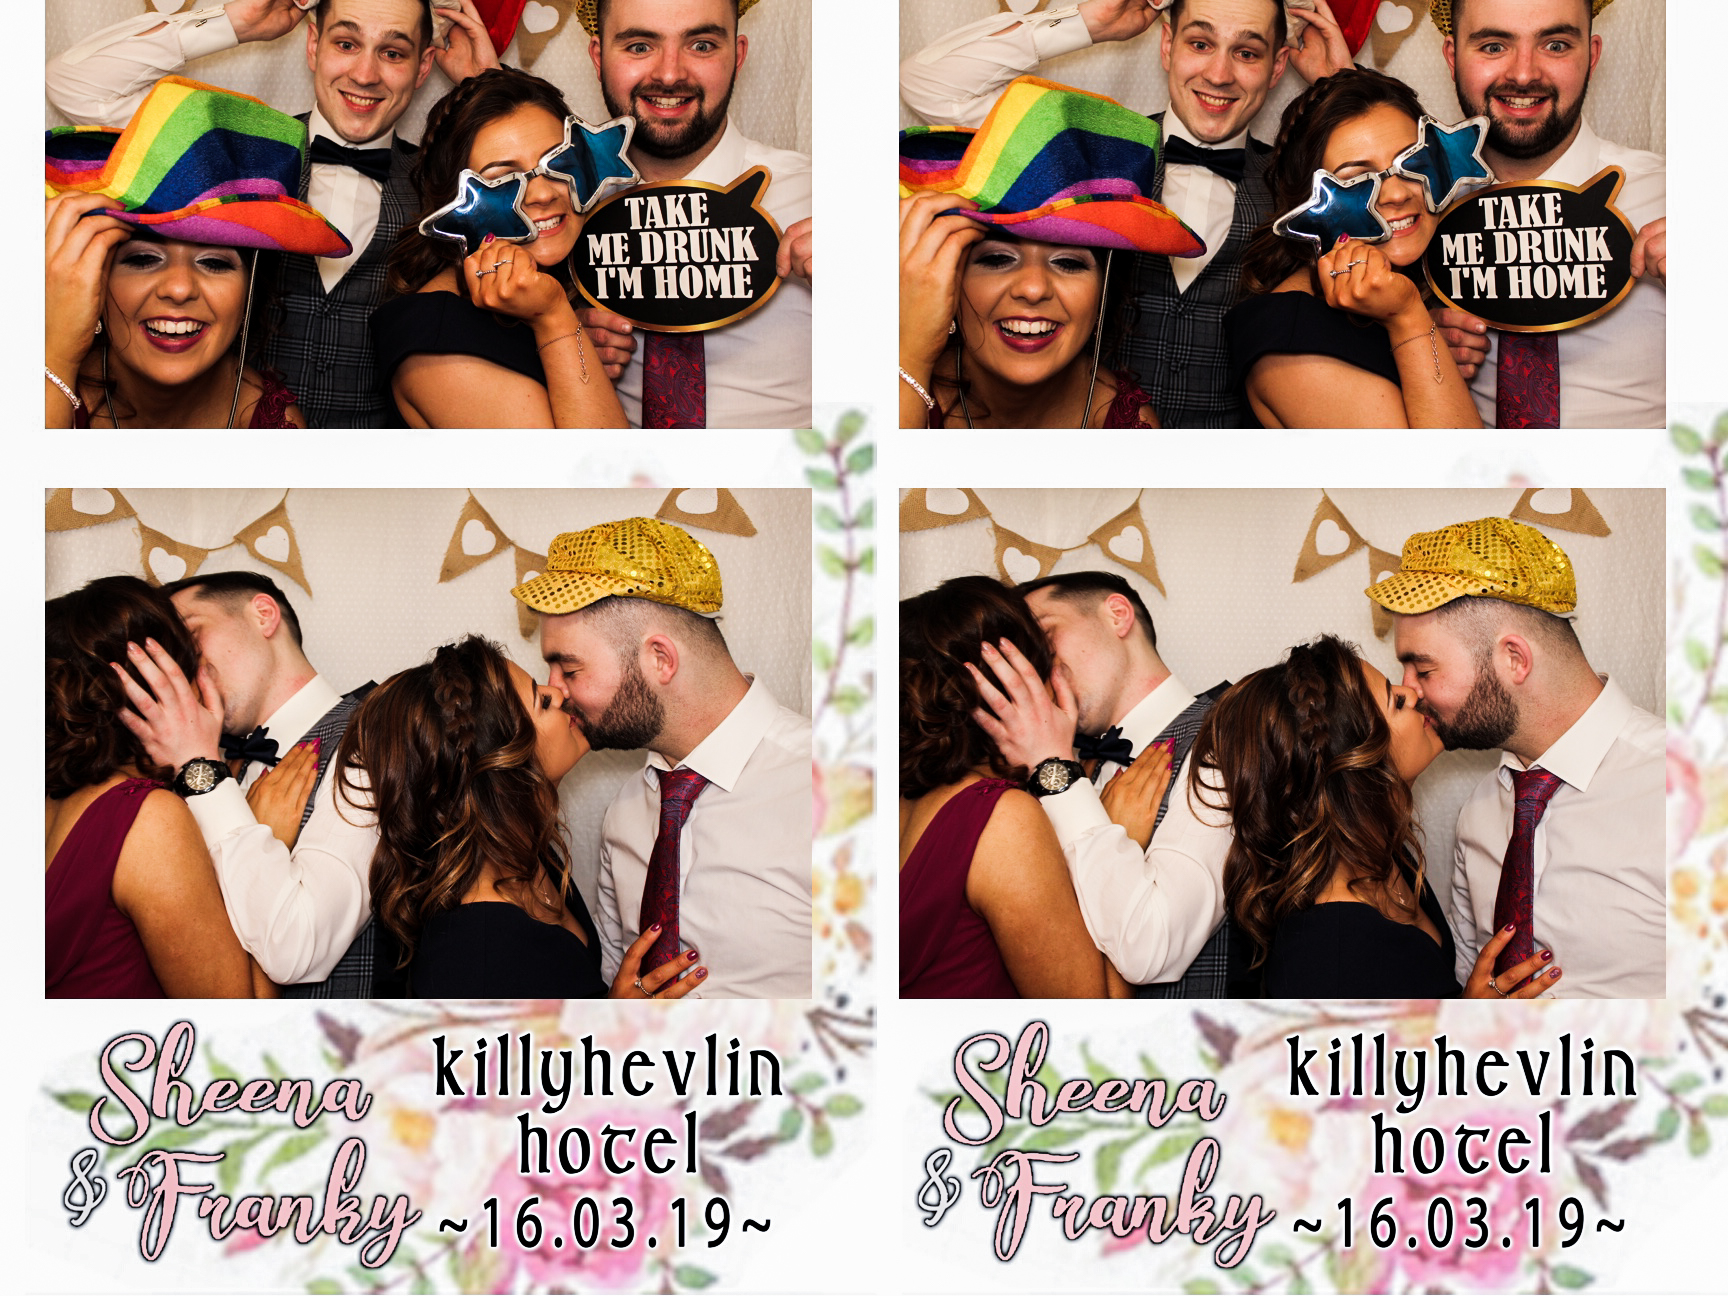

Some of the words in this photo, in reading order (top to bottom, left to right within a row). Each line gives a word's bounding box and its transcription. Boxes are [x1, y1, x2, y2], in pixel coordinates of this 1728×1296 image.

[624, 192, 710, 230] TAKE
[1478, 192, 1564, 230] TAKE
[587, 233, 630, 265] ME
[638, 226, 759, 264] DRUNK
[1441, 233, 1484, 265] ME
[1492, 226, 1613, 264] DRUNK
[595, 267, 644, 299] I'M
[652, 264, 753, 299] HOME
[1449, 267, 1498, 299] I'M
[1506, 264, 1607, 299] HOME
